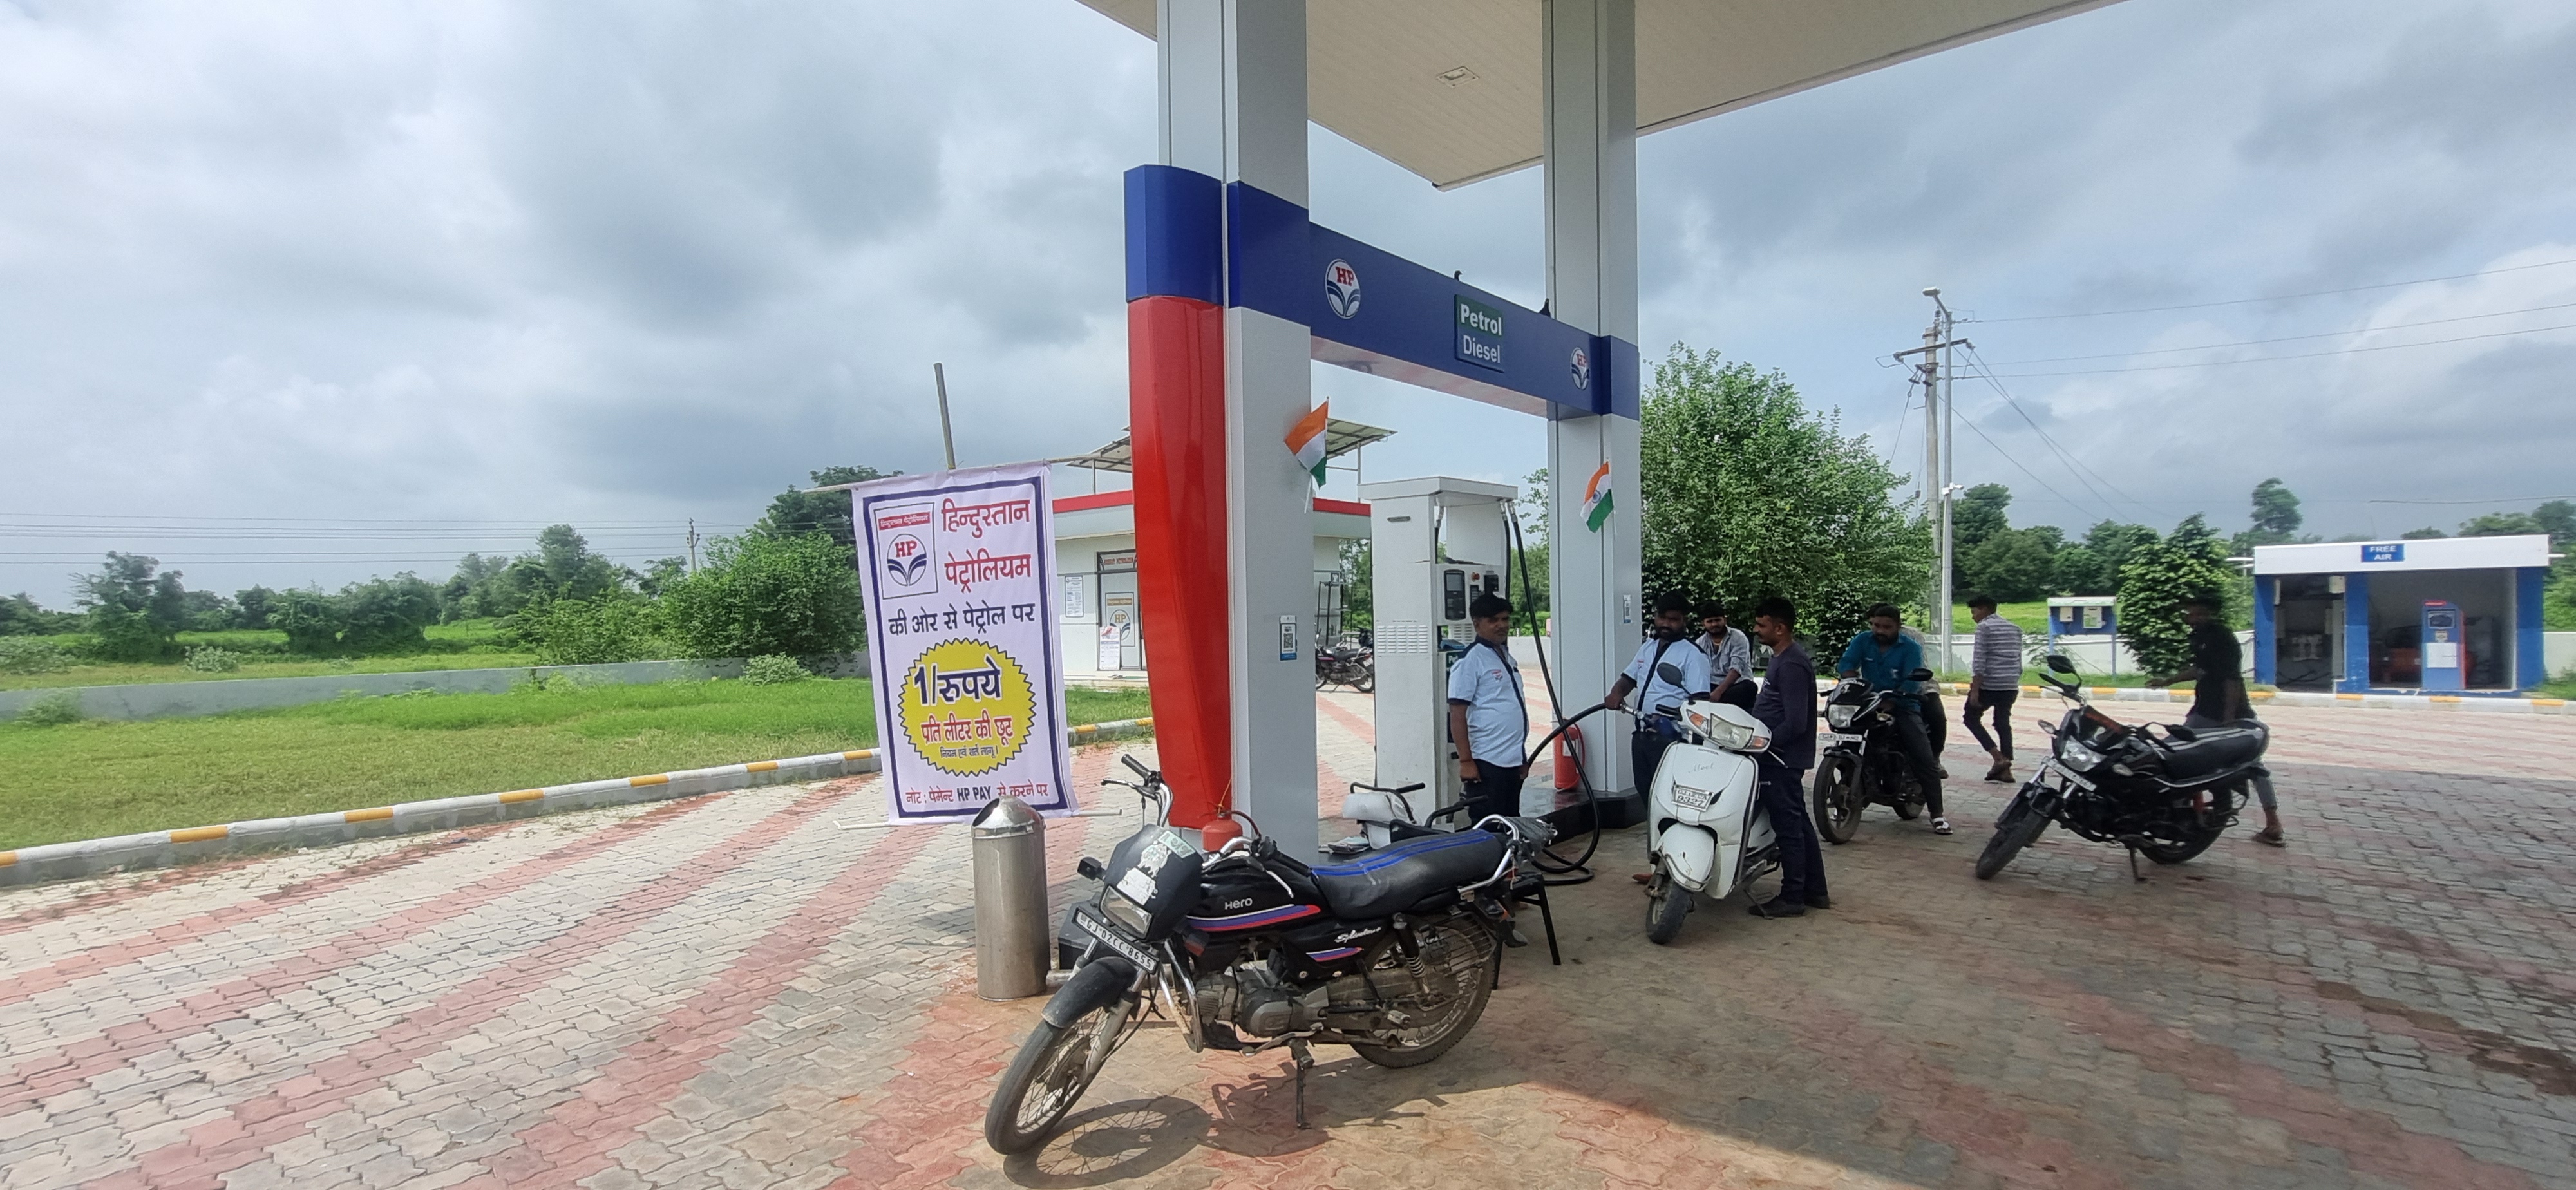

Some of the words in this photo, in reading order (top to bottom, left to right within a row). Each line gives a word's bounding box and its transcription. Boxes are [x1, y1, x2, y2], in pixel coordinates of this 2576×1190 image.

[1335, 265, 1354, 287] HP
[1461, 303, 1502, 335] Petrol
[1463, 335, 1501, 363] Diesel
[1576, 353, 1587, 368] HP
[941, 498, 1030, 538] हिन्दुस्तान
[895, 540, 917, 558] HP
[944, 548, 1031, 593] पेट्रोलियम
[888, 608, 908, 636] की
[912, 606, 938, 633] ओर
[943, 603, 958, 630] से
[963, 599, 1005, 634] पेट्रोल
[1011, 603, 1035, 623] पर
[1114, 614, 1126, 623] HP
[943, 712, 972, 741] लीटर
[974, 710, 991, 739] की
[994, 717, 1013, 746] छूट
[957, 787, 970, 802] HP
[972, 786, 991, 800] PAY
[1036, 784, 1048, 797] पर
[1678, 795, 1705, 806] 9327
[1224, 898, 1253, 911] Hero
